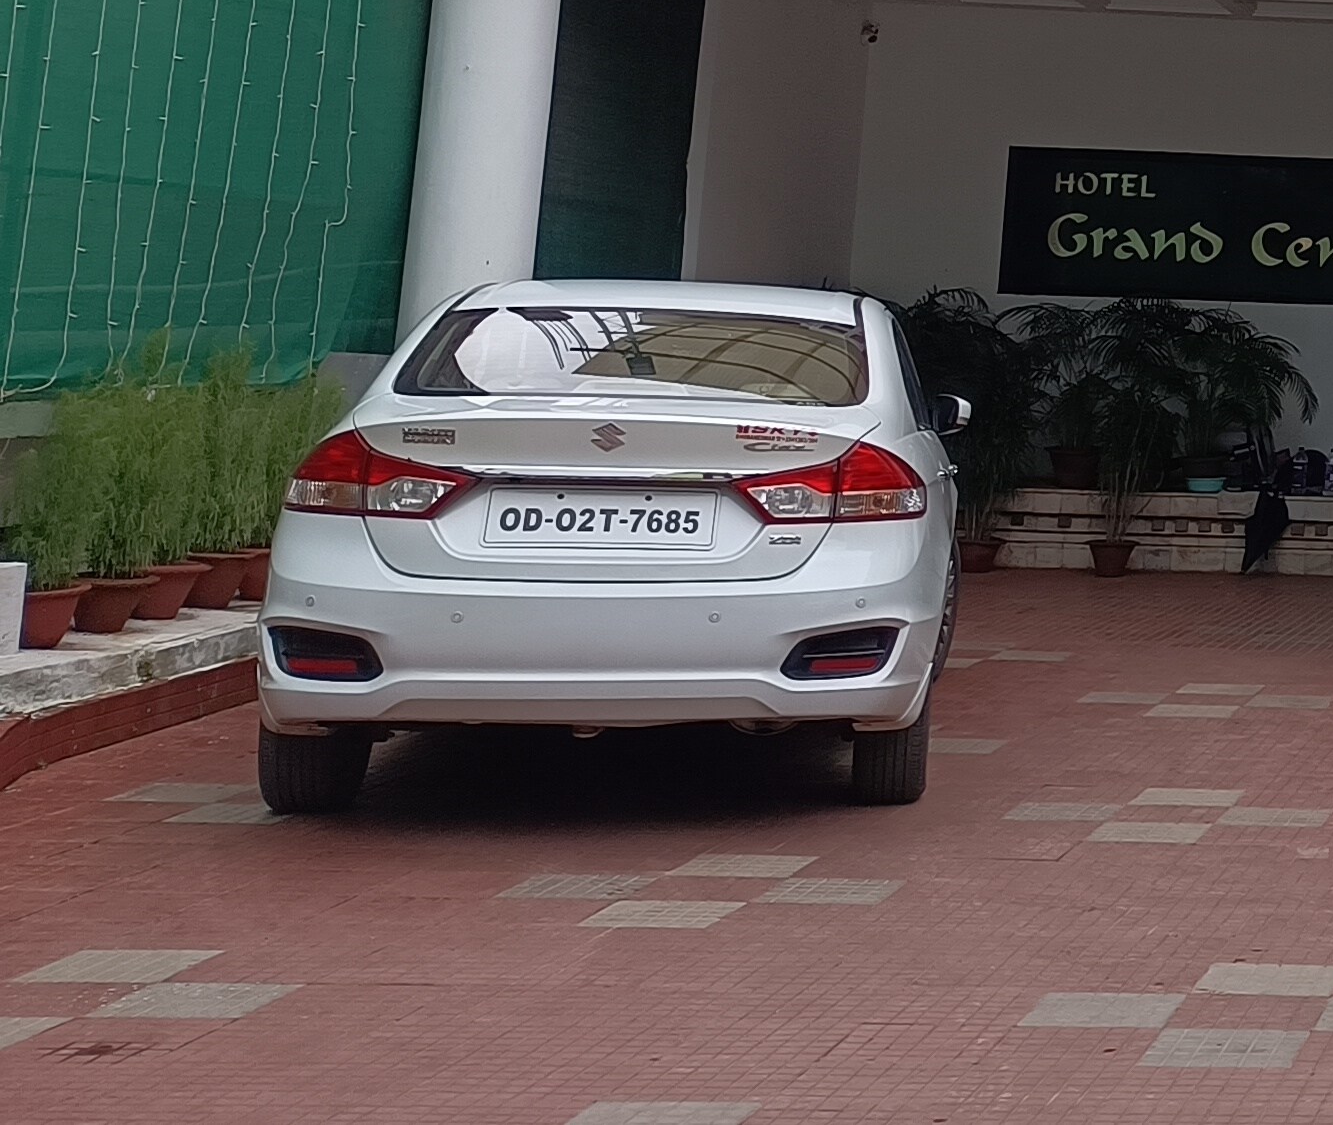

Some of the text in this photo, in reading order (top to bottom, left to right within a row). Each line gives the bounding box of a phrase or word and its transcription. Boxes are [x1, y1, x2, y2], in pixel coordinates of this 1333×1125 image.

[1054, 172, 1156, 198] HOTEL
[1047, 213, 1224, 264] Grand
[499, 507, 700, 534] OD-02T-7685
